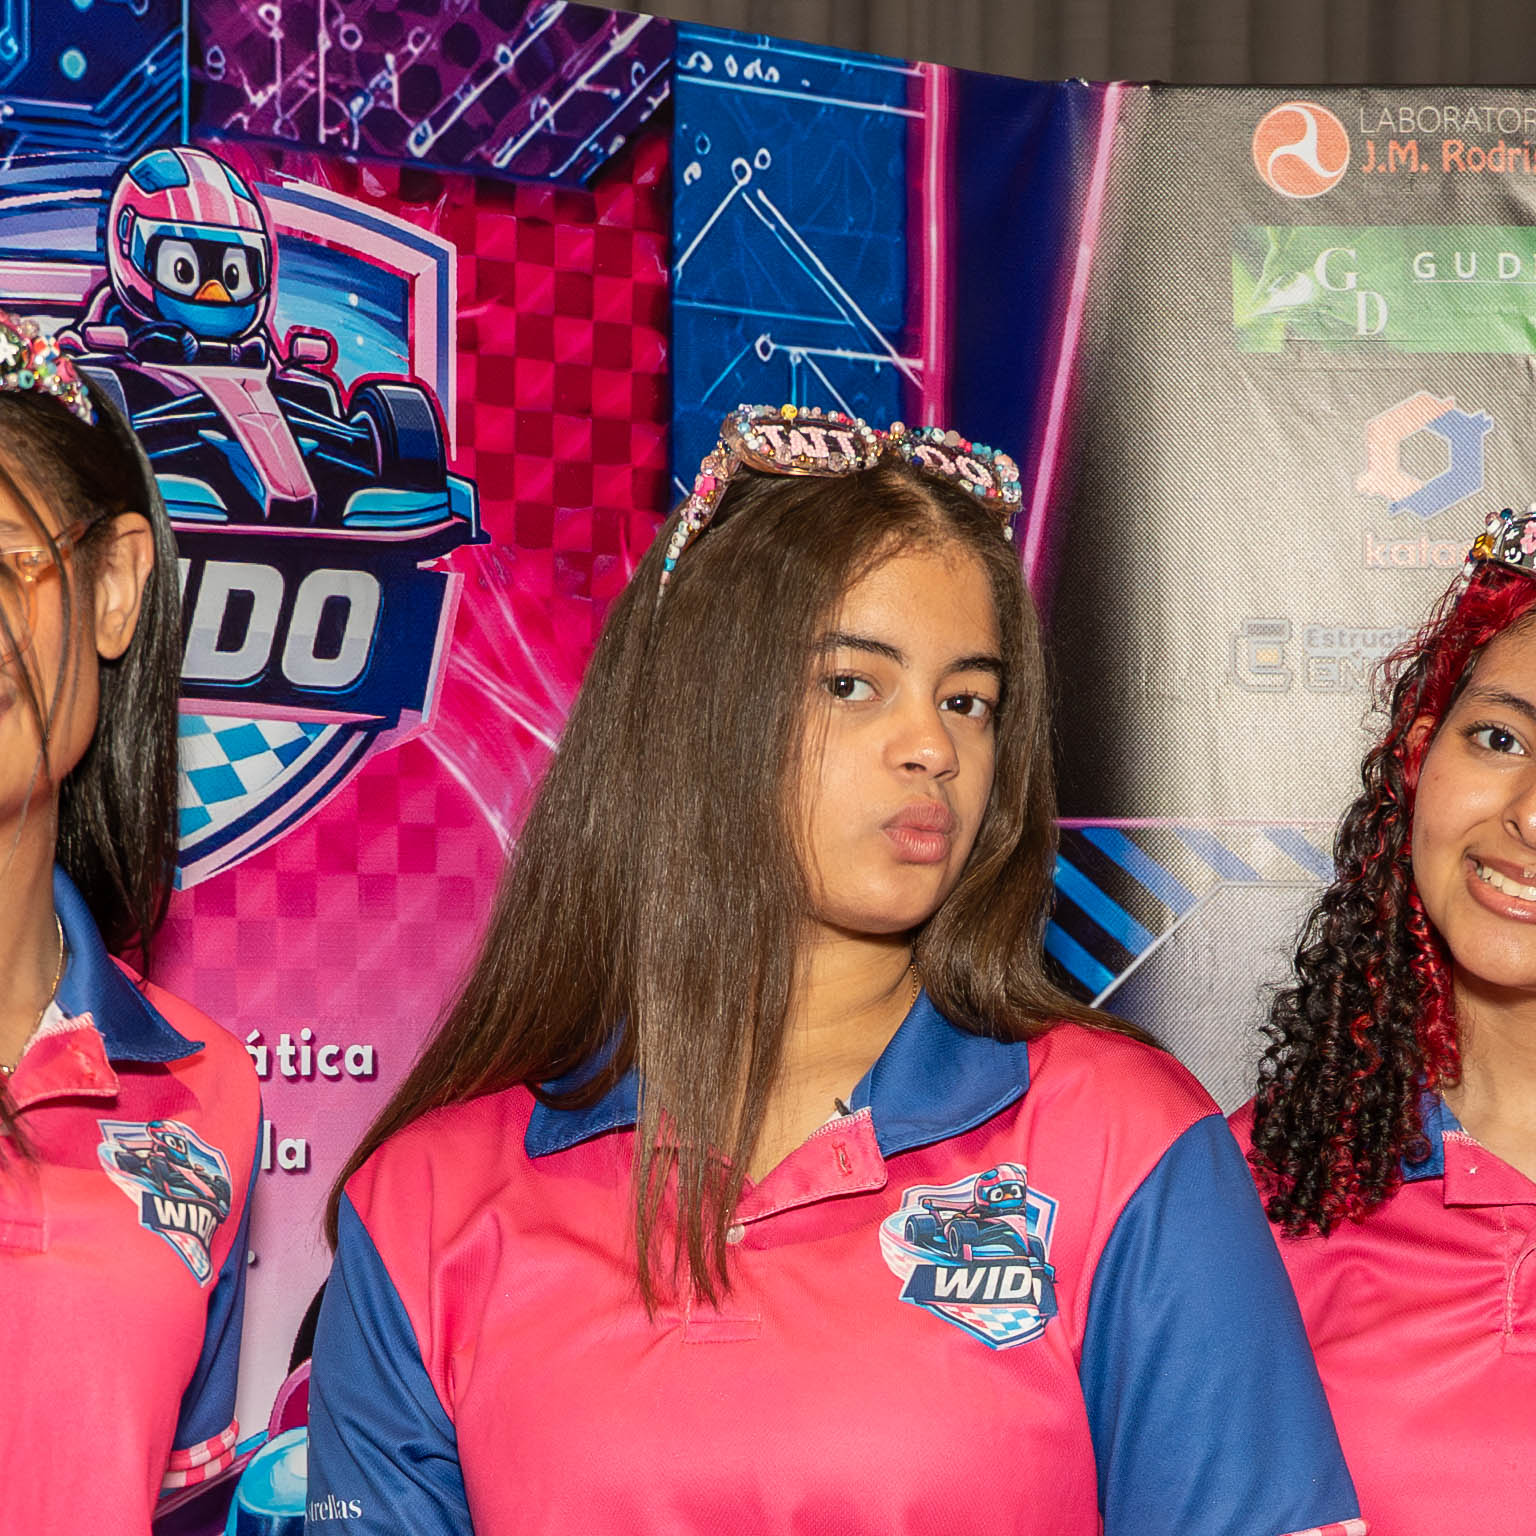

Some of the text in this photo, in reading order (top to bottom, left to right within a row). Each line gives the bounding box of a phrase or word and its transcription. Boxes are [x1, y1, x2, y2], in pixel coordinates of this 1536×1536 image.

[1361, 139, 1429, 174] J.M.
[178, 560, 381, 688] DO
[247, 1027, 375, 1077] ática
